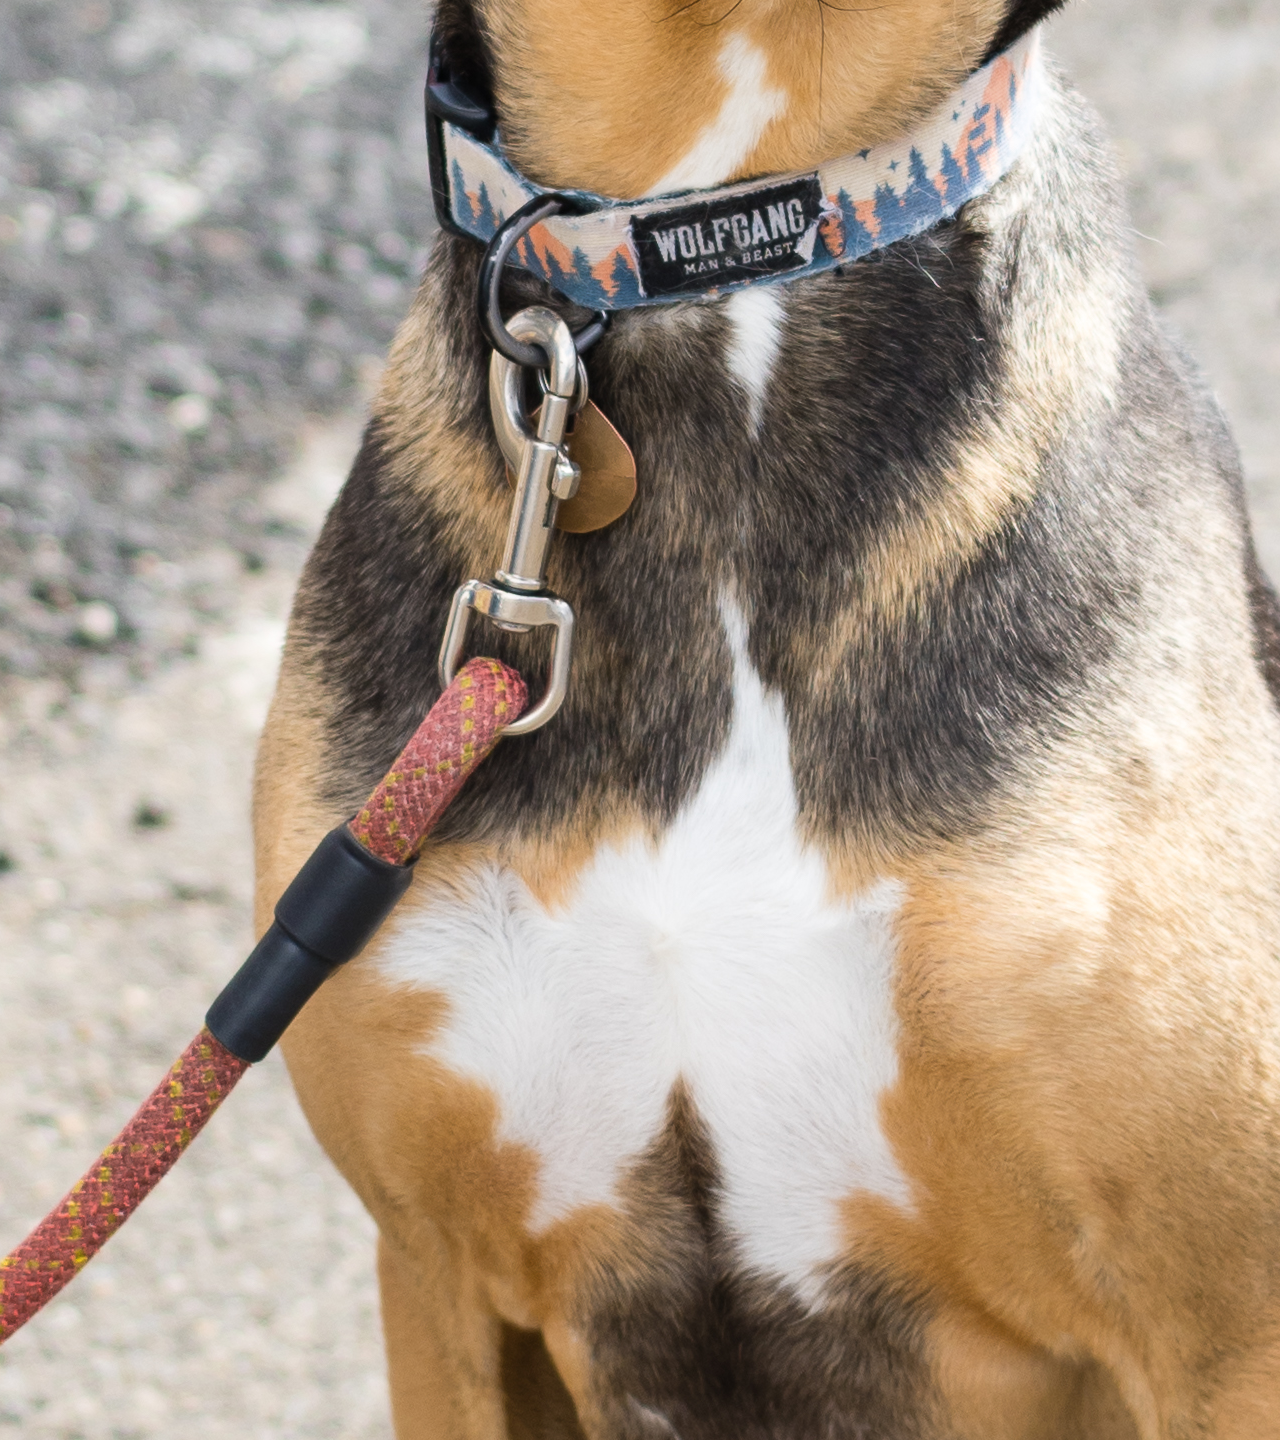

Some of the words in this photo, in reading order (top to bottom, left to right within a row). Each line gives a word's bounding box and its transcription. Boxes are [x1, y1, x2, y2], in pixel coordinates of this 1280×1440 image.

[650, 198, 806, 263] WOLFGANG
[683, 255, 720, 276] MAN
[724, 256, 737, 268] &
[742, 241, 794, 265] BEAST
